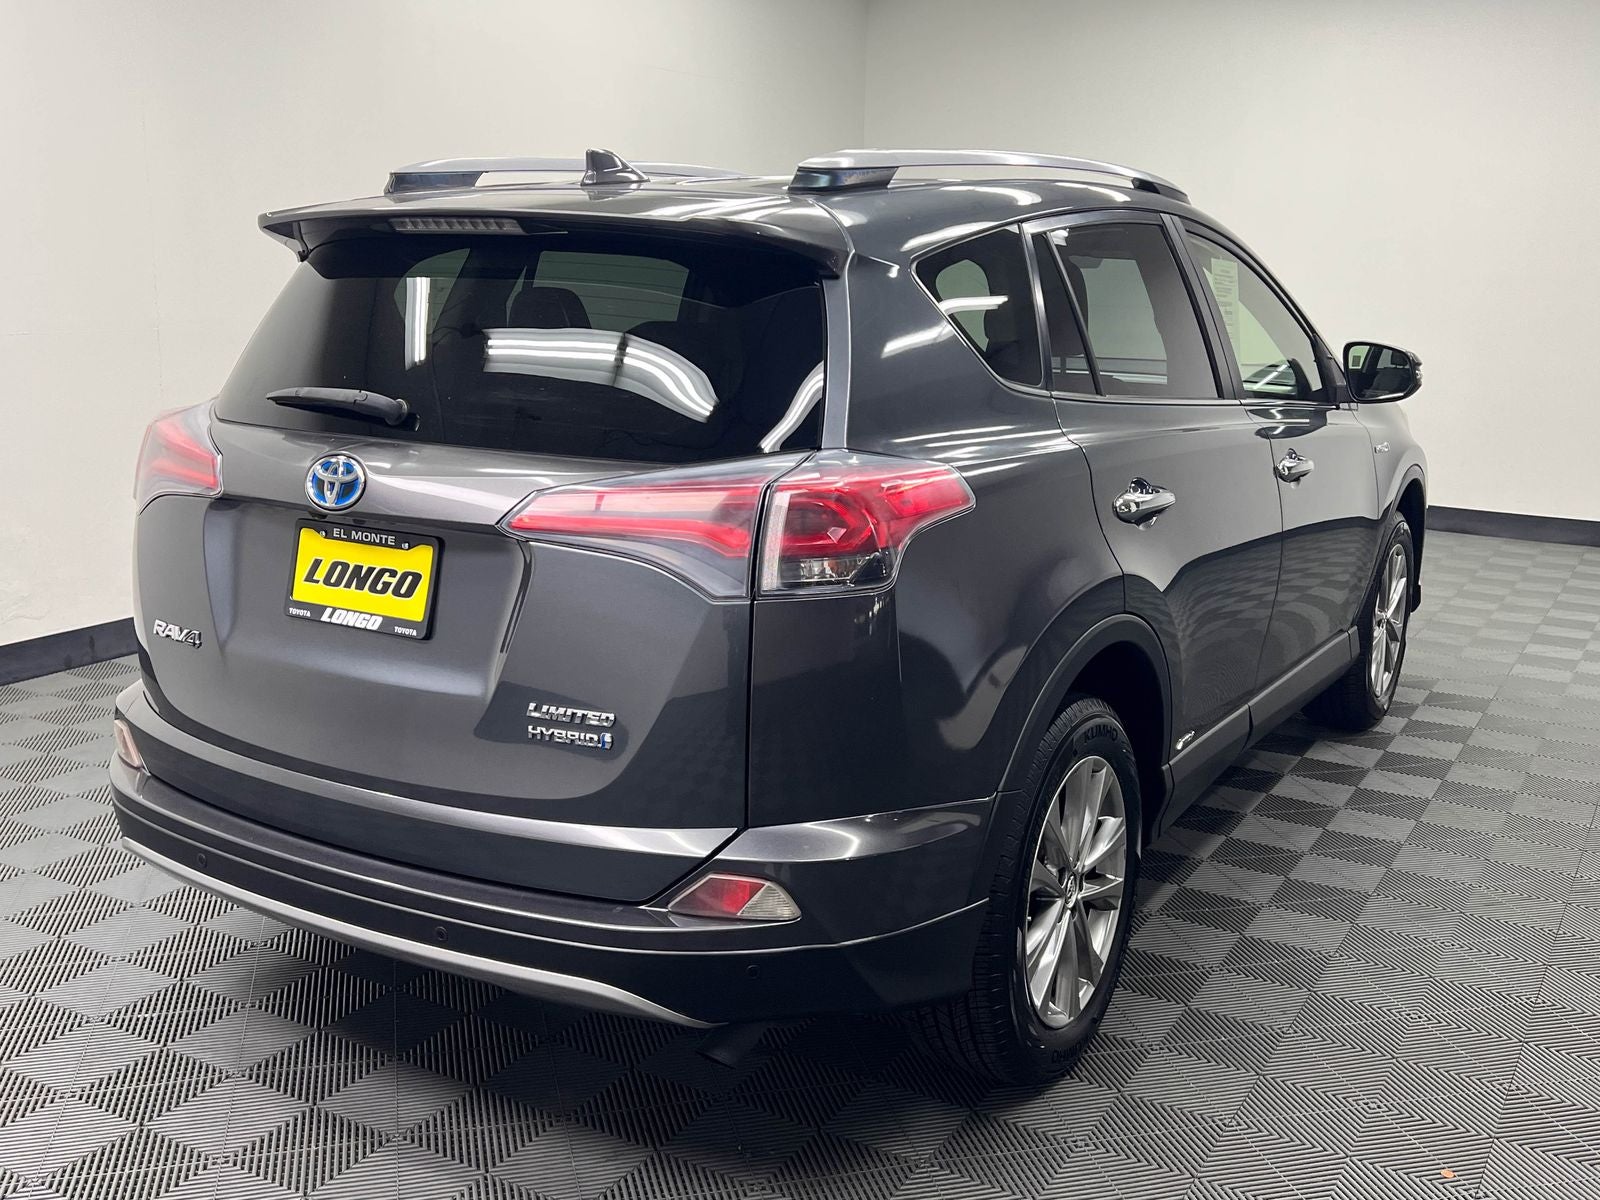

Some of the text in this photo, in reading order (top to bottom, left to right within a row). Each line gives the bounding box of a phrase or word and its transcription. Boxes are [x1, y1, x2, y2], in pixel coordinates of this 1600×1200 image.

[333, 527, 396, 546] EL MONTE
[302, 557, 424, 600] LONGO
[153, 619, 202, 649] RAV4
[288, 607, 418, 637] TOYOTA LONGO TOYOTA
[526, 702, 616, 728] LIMITED
[527, 725, 600, 748] HYBRID
[1083, 724, 1119, 744] KUMHO
